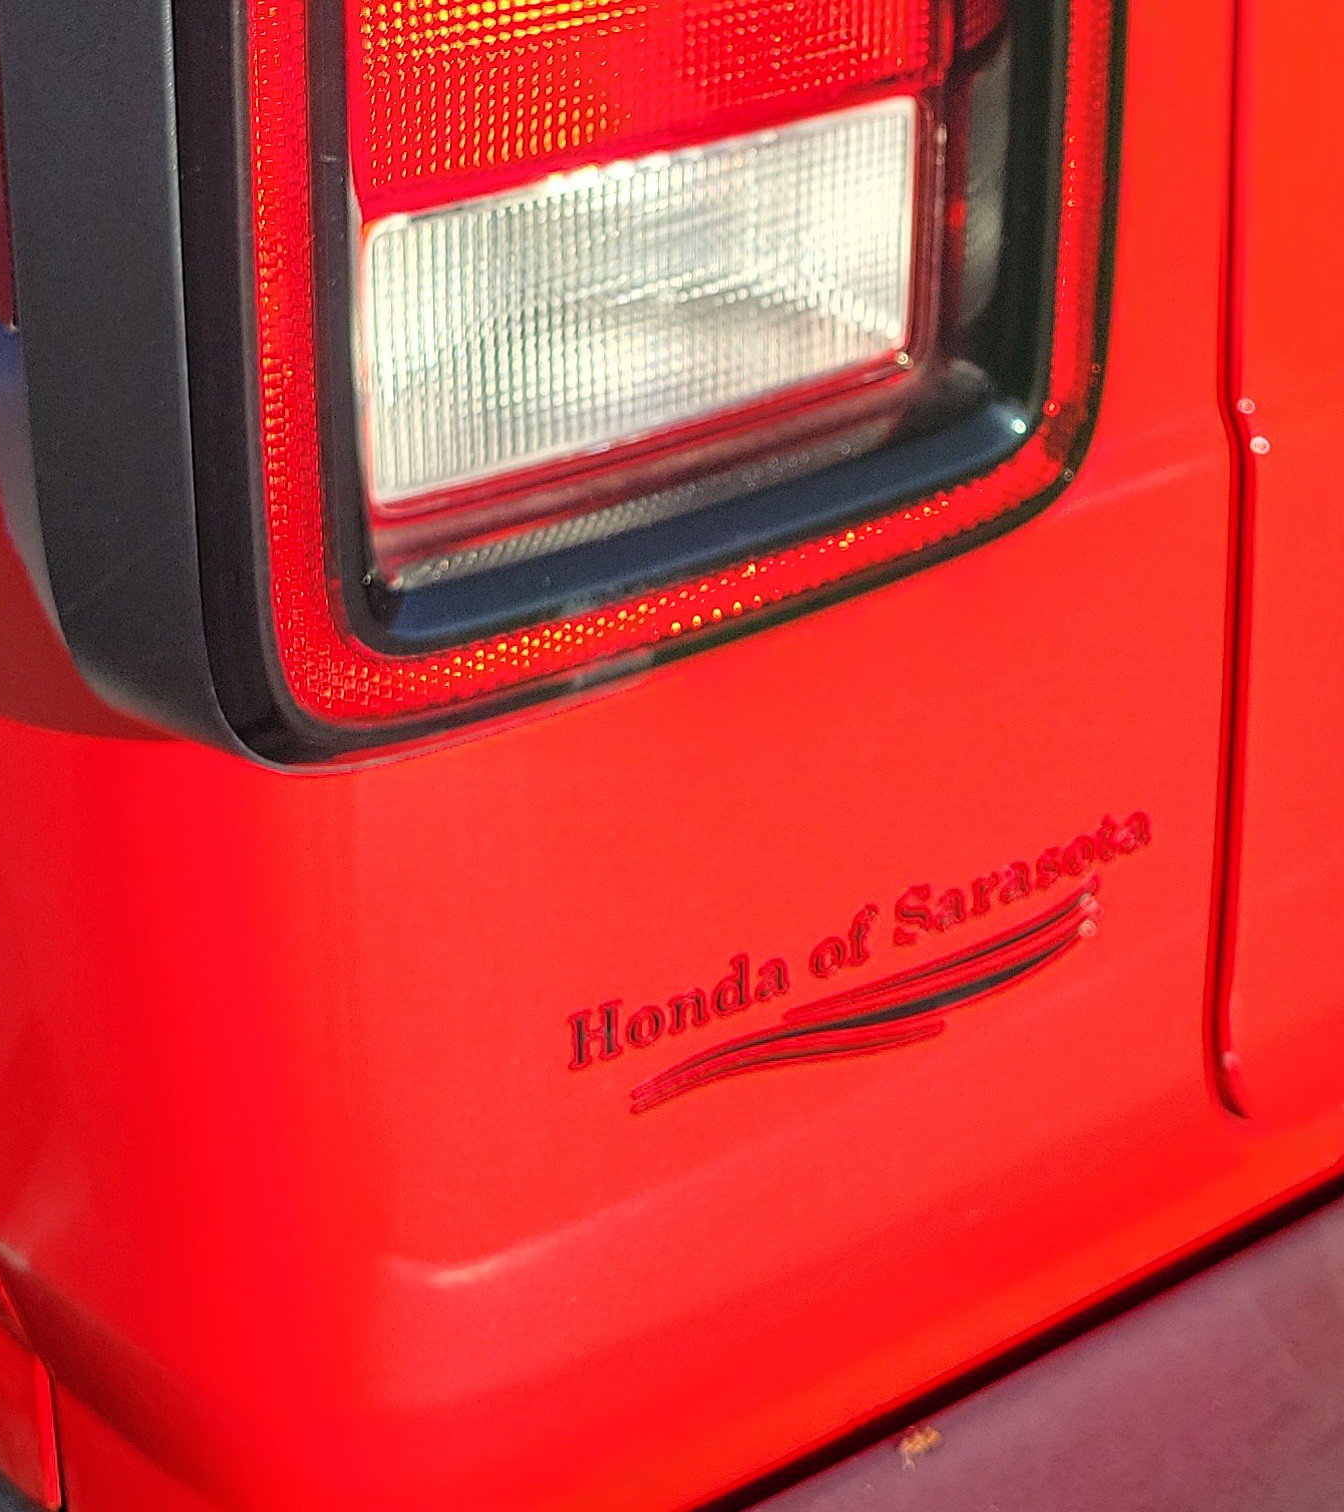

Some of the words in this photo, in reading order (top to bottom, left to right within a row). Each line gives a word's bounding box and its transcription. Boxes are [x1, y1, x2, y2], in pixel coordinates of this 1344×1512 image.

[567, 952, 790, 1070] Honda
[809, 903, 879, 978] of
[893, 811, 1151, 946] Sarasota
